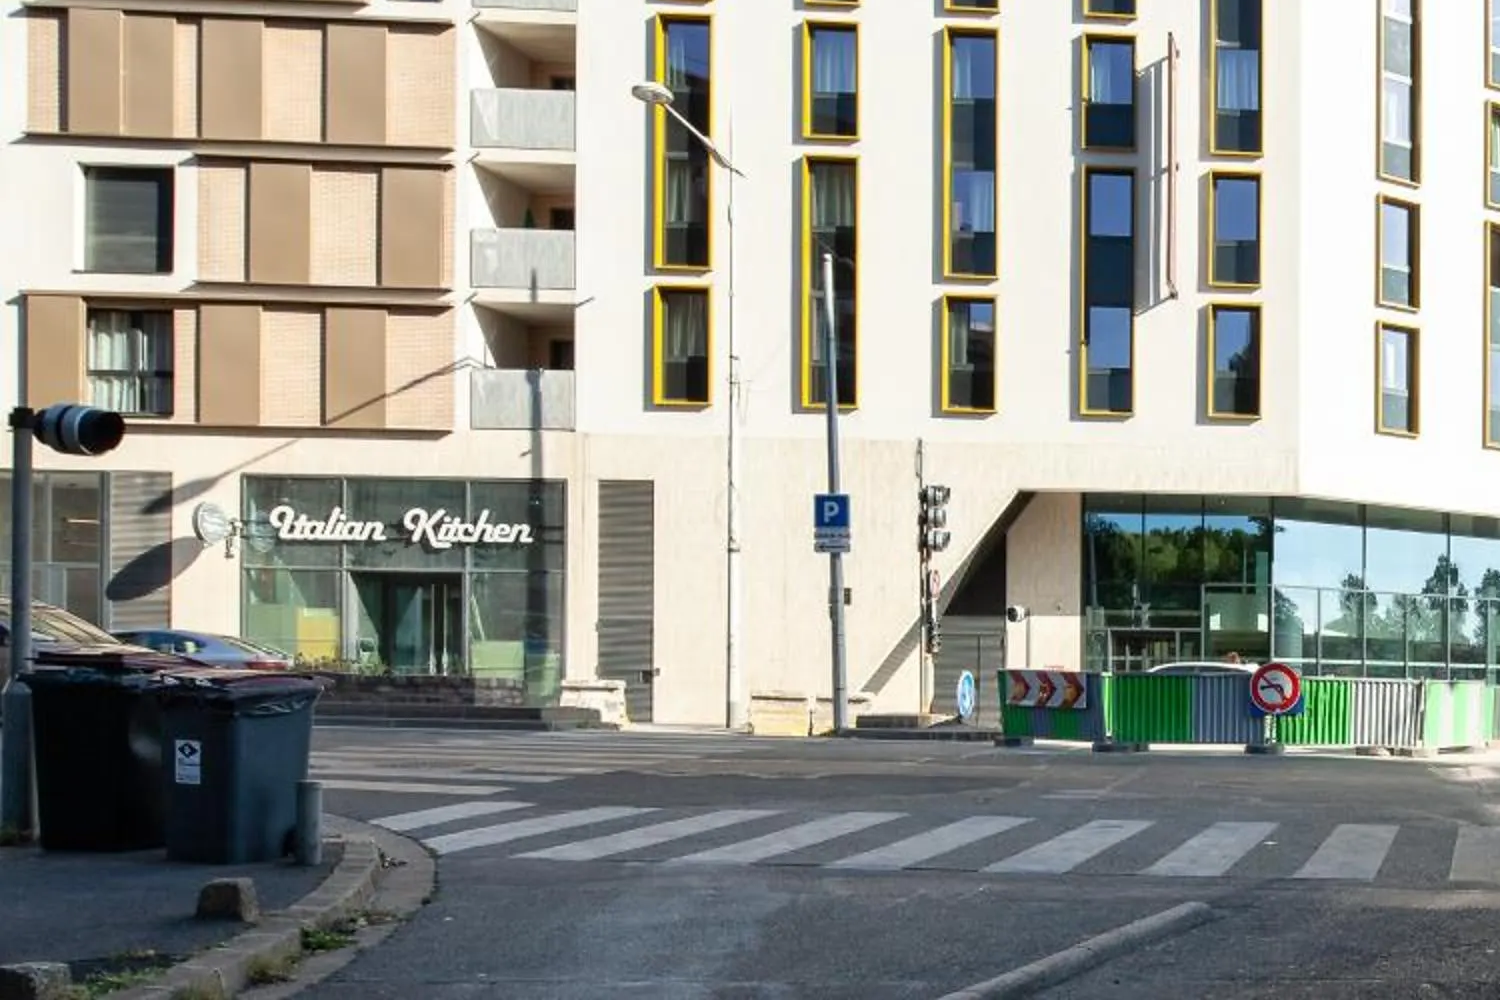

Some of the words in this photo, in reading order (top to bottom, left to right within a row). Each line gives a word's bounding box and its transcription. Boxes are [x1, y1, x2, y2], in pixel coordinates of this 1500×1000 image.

[269, 505, 387, 541] Italian
[403, 507, 534, 549] Kitchen
[823, 501, 840, 523] P
